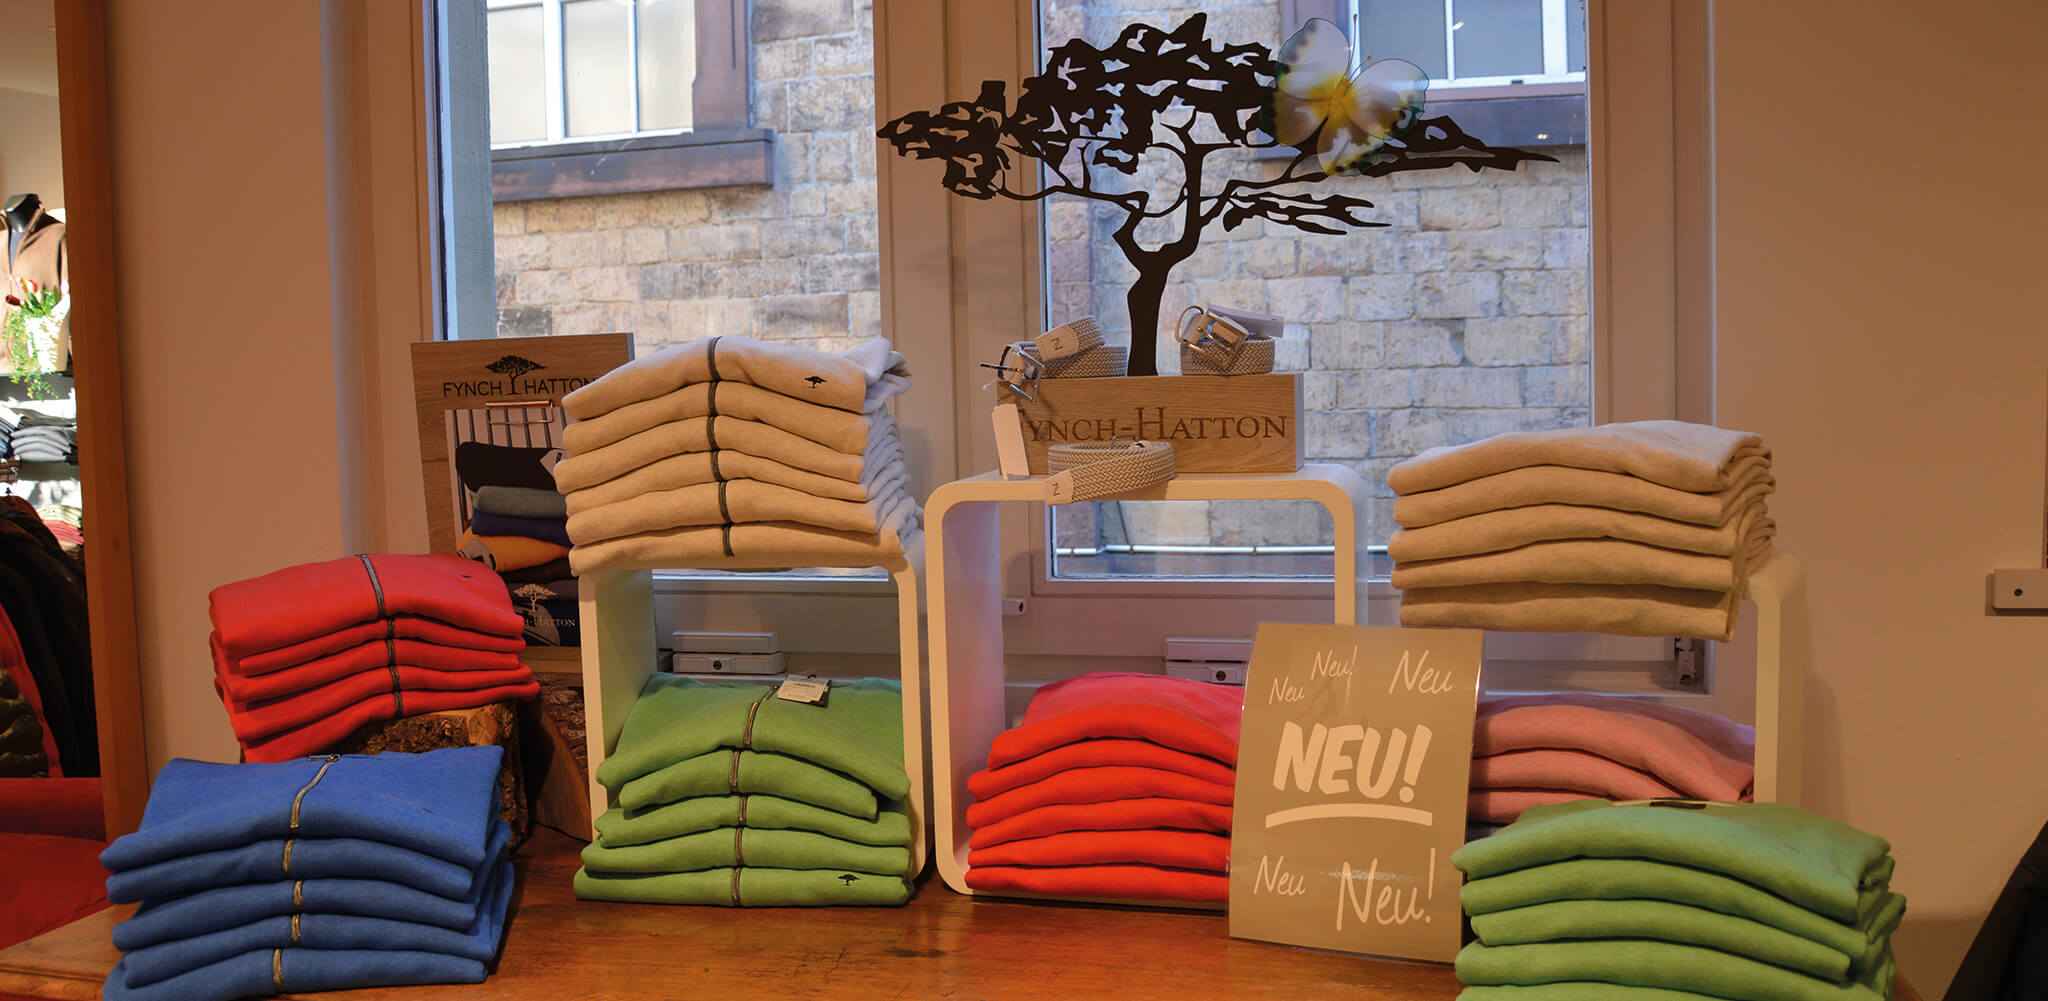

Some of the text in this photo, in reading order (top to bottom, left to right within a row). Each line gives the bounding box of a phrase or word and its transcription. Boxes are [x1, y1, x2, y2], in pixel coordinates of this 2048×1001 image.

[443, 381, 503, 397] FYNCH
[1310, 645, 1358, 682] Neu!
[1388, 649, 1454, 695] Neu
[1268, 676, 1305, 704] Neu
[1272, 720, 1433, 803] NEU!
[1253, 855, 1306, 896] Neu
[1336, 847, 1436, 931] Neu!
